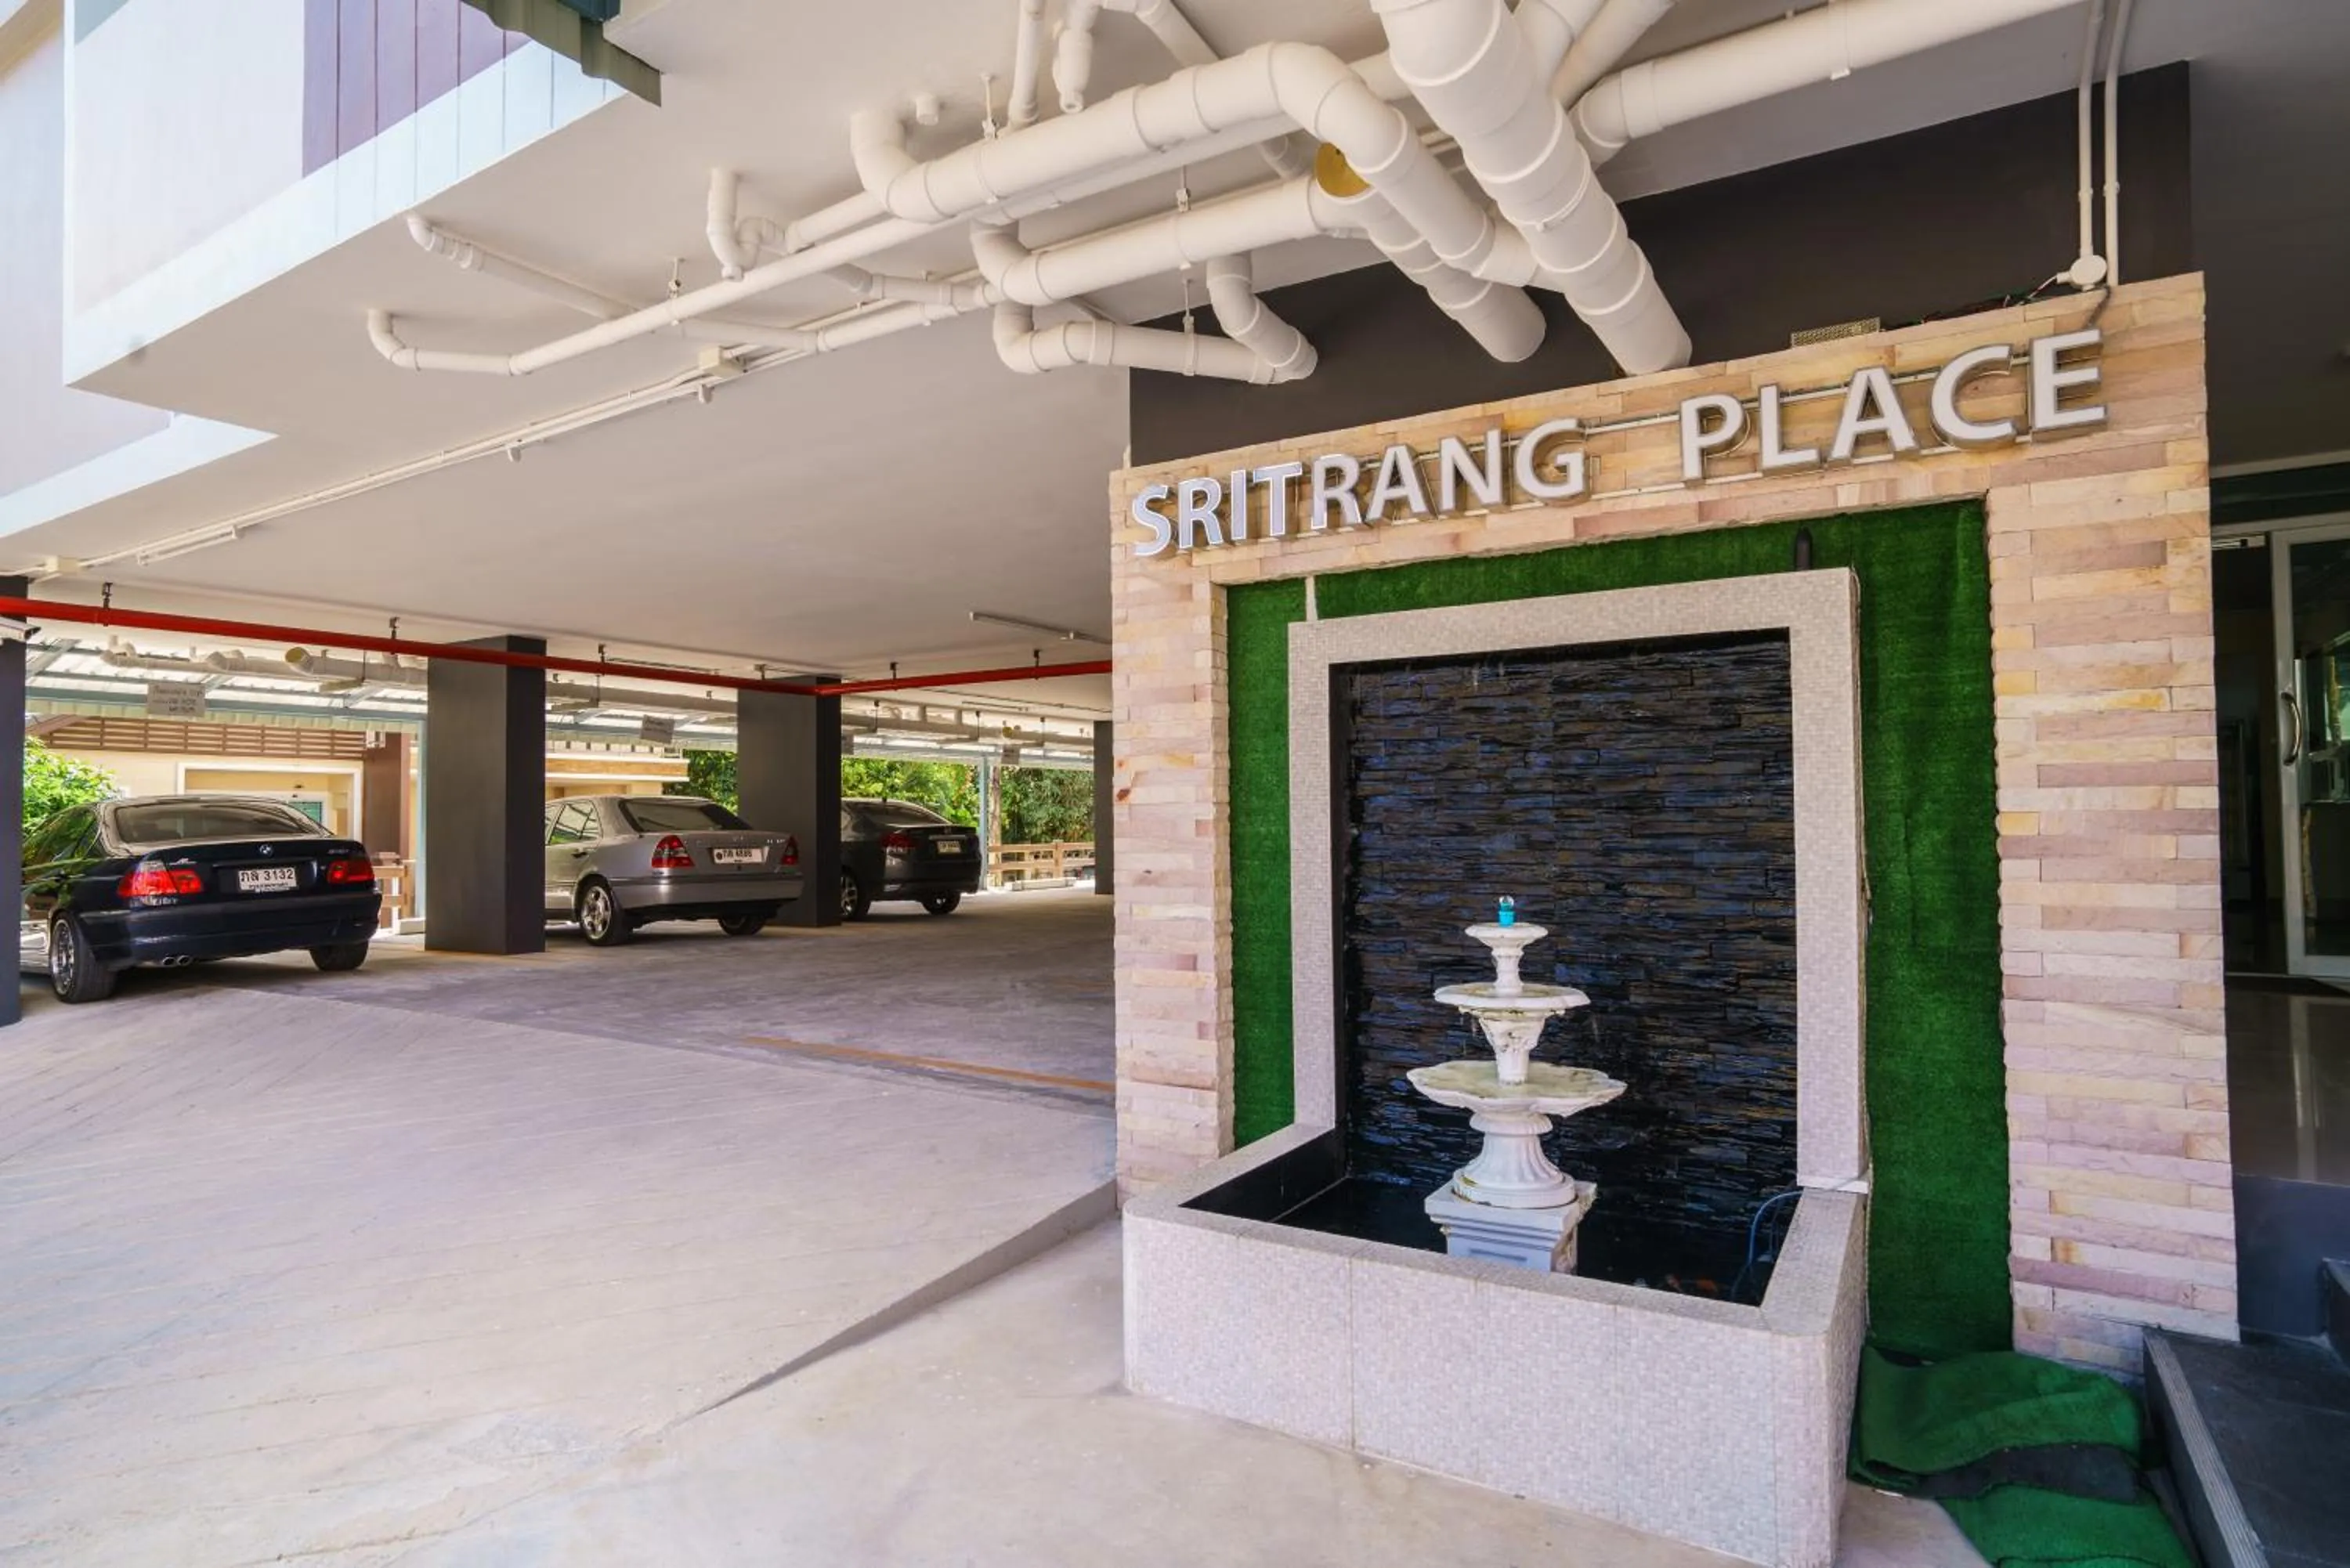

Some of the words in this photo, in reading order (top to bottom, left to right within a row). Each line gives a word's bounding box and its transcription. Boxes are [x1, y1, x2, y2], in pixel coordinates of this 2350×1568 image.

[1131, 417, 1589, 557] SRITRANG
[1679, 327, 2108, 484] PLACE
[263, 869, 294, 881] 3132
